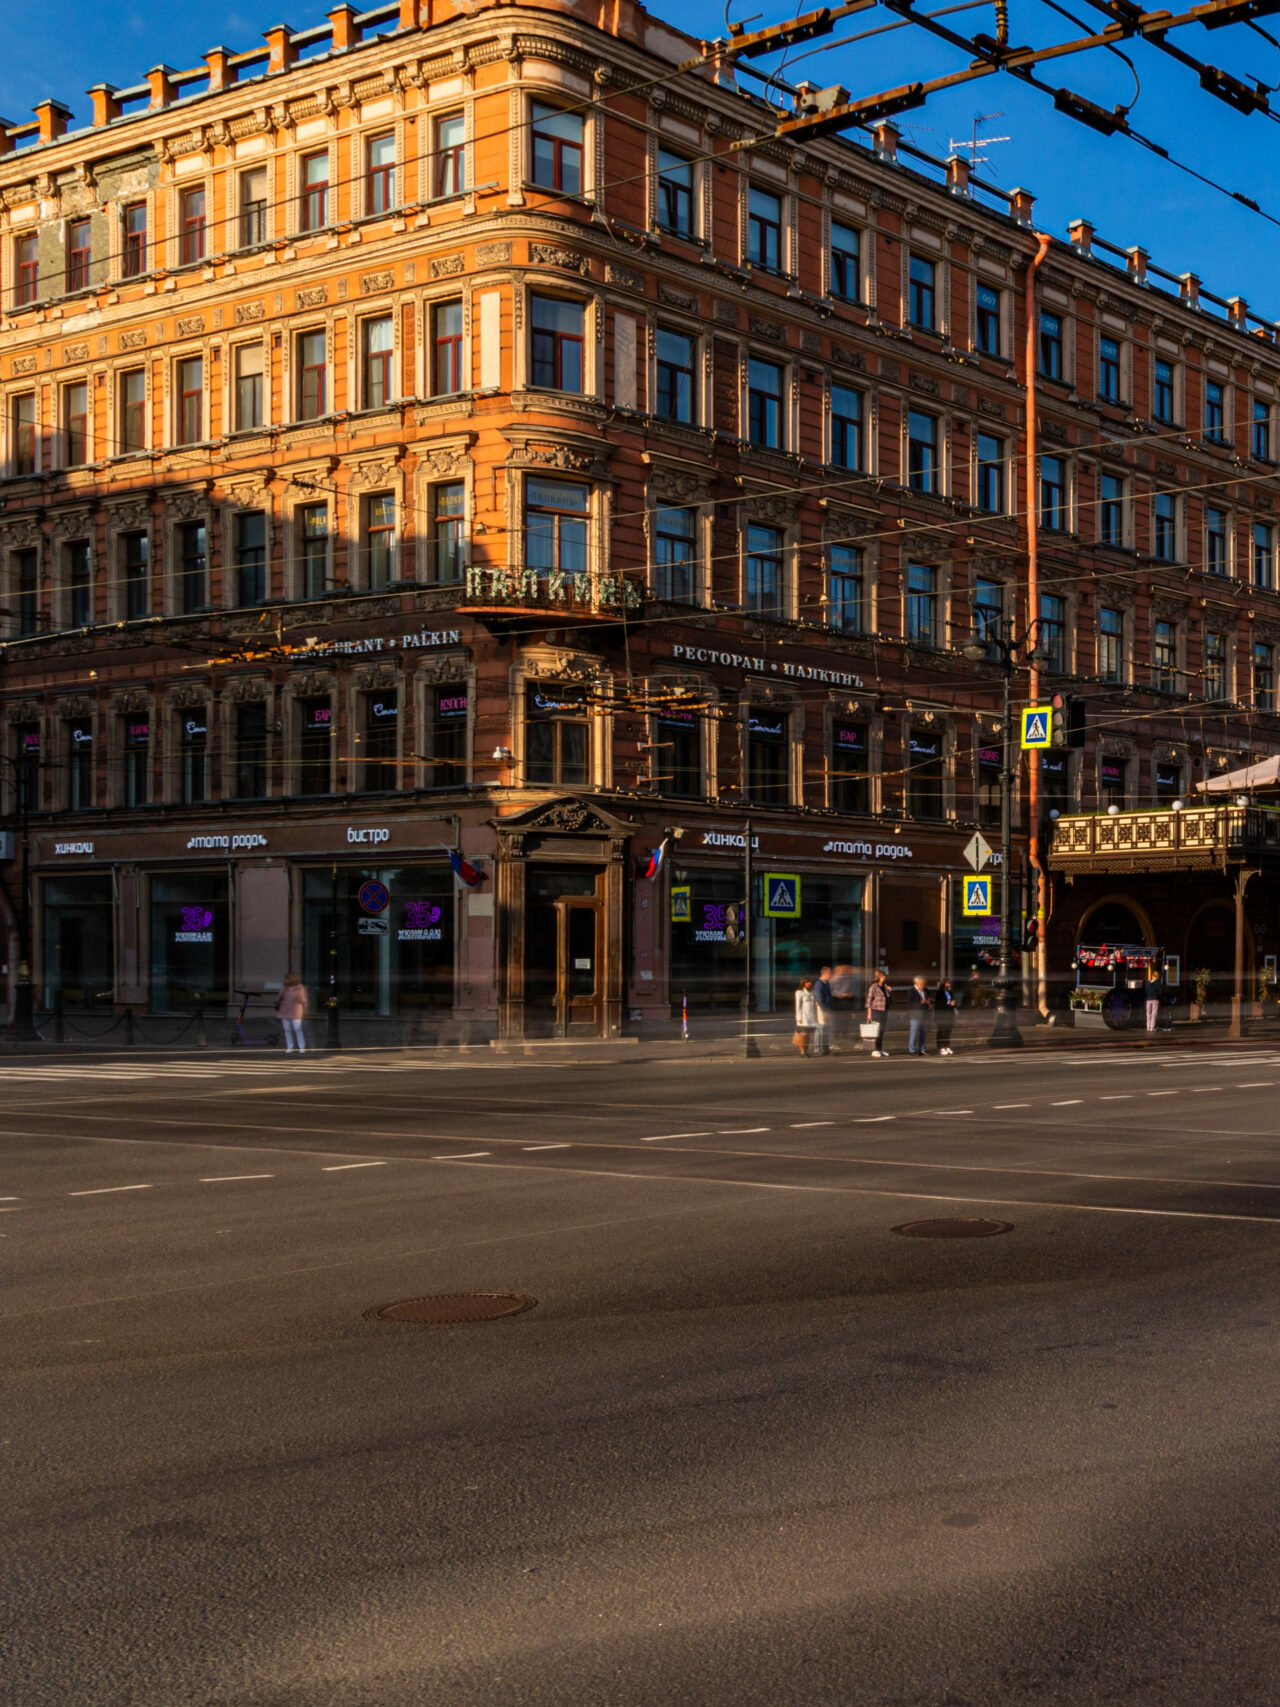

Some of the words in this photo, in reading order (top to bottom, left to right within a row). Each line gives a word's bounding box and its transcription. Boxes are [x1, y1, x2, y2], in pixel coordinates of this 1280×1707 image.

[402, 630, 459, 648] PALKIN
[672, 644, 765, 672] РЕСТОРАН
[783, 662, 864, 689] ПАЛКИНЪ
[347, 827, 390, 843] бистро
[703, 833, 759, 848] хинкаи
